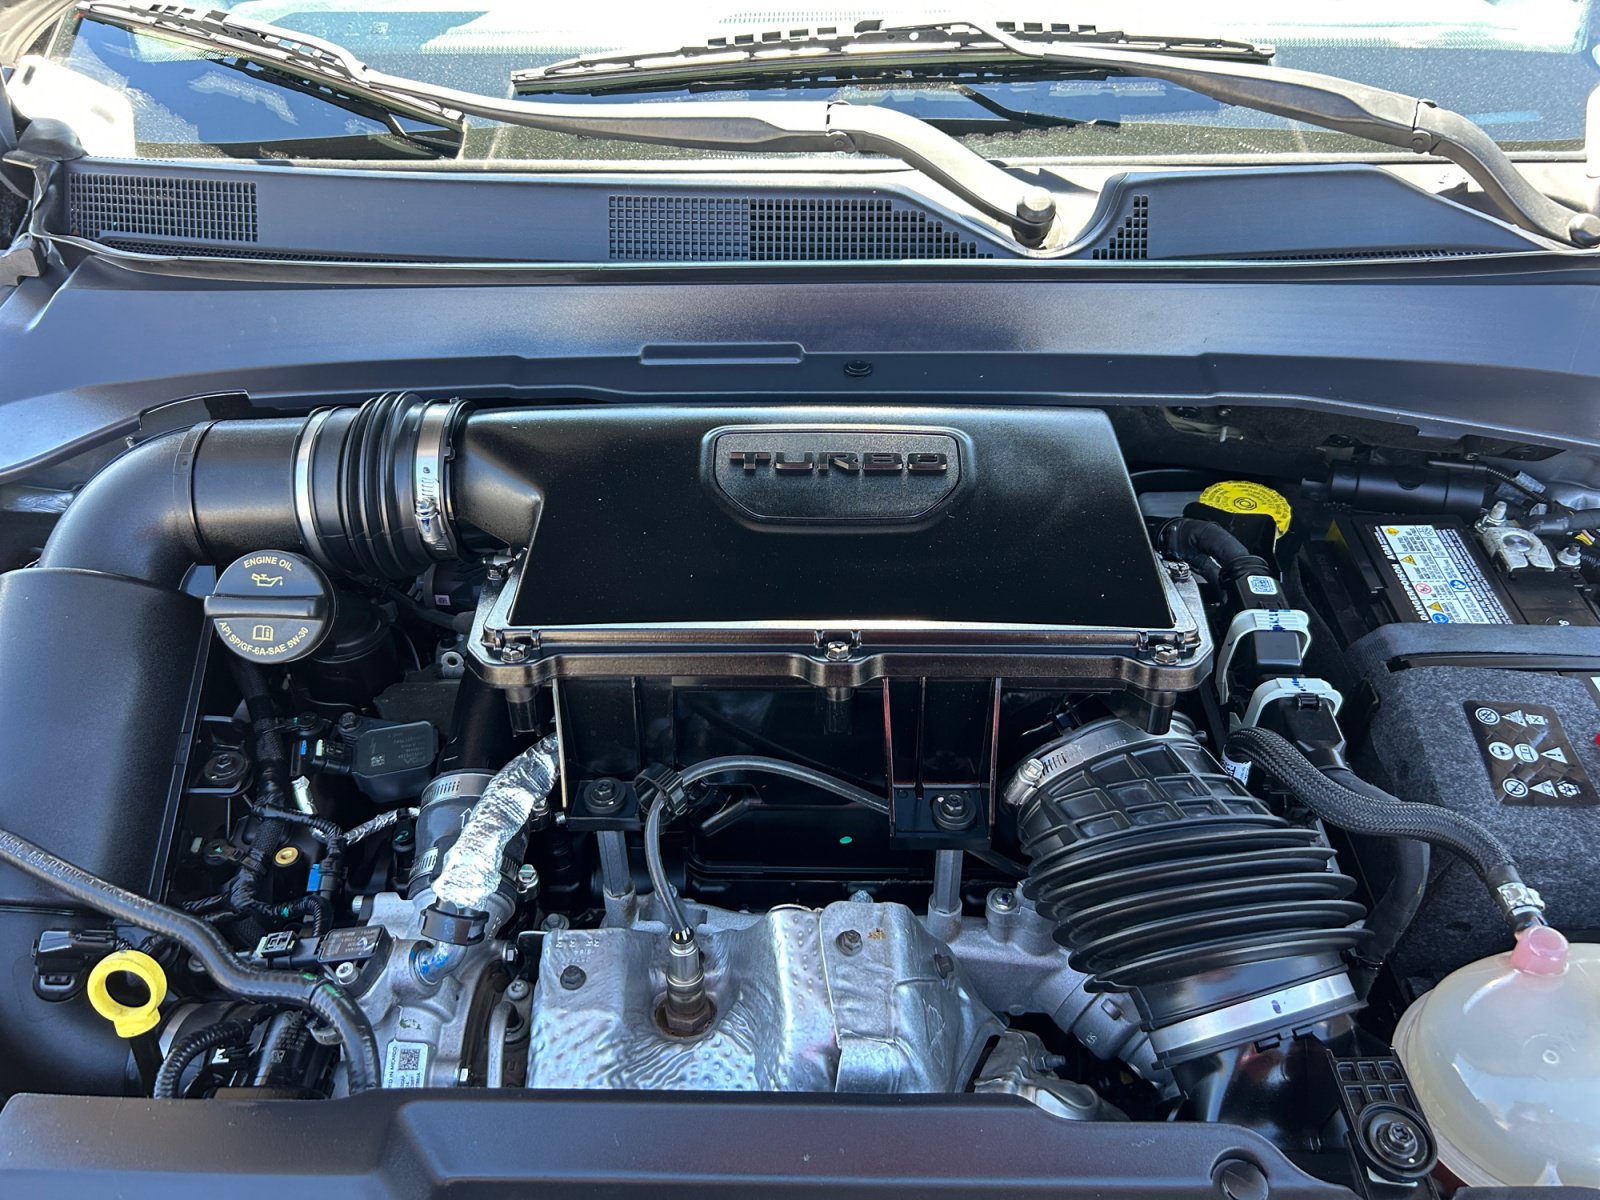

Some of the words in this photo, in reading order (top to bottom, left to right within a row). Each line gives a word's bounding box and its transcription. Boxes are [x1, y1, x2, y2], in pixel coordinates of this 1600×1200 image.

[729, 451, 948, 471] TURBO
[243, 556, 278, 569] ENGINE
[278, 559, 293, 571] OIL
[219, 621, 233, 637] API
[229, 633, 288, 656] SP/GF-6A-SAE
[286, 626, 309, 649] 5W-30
